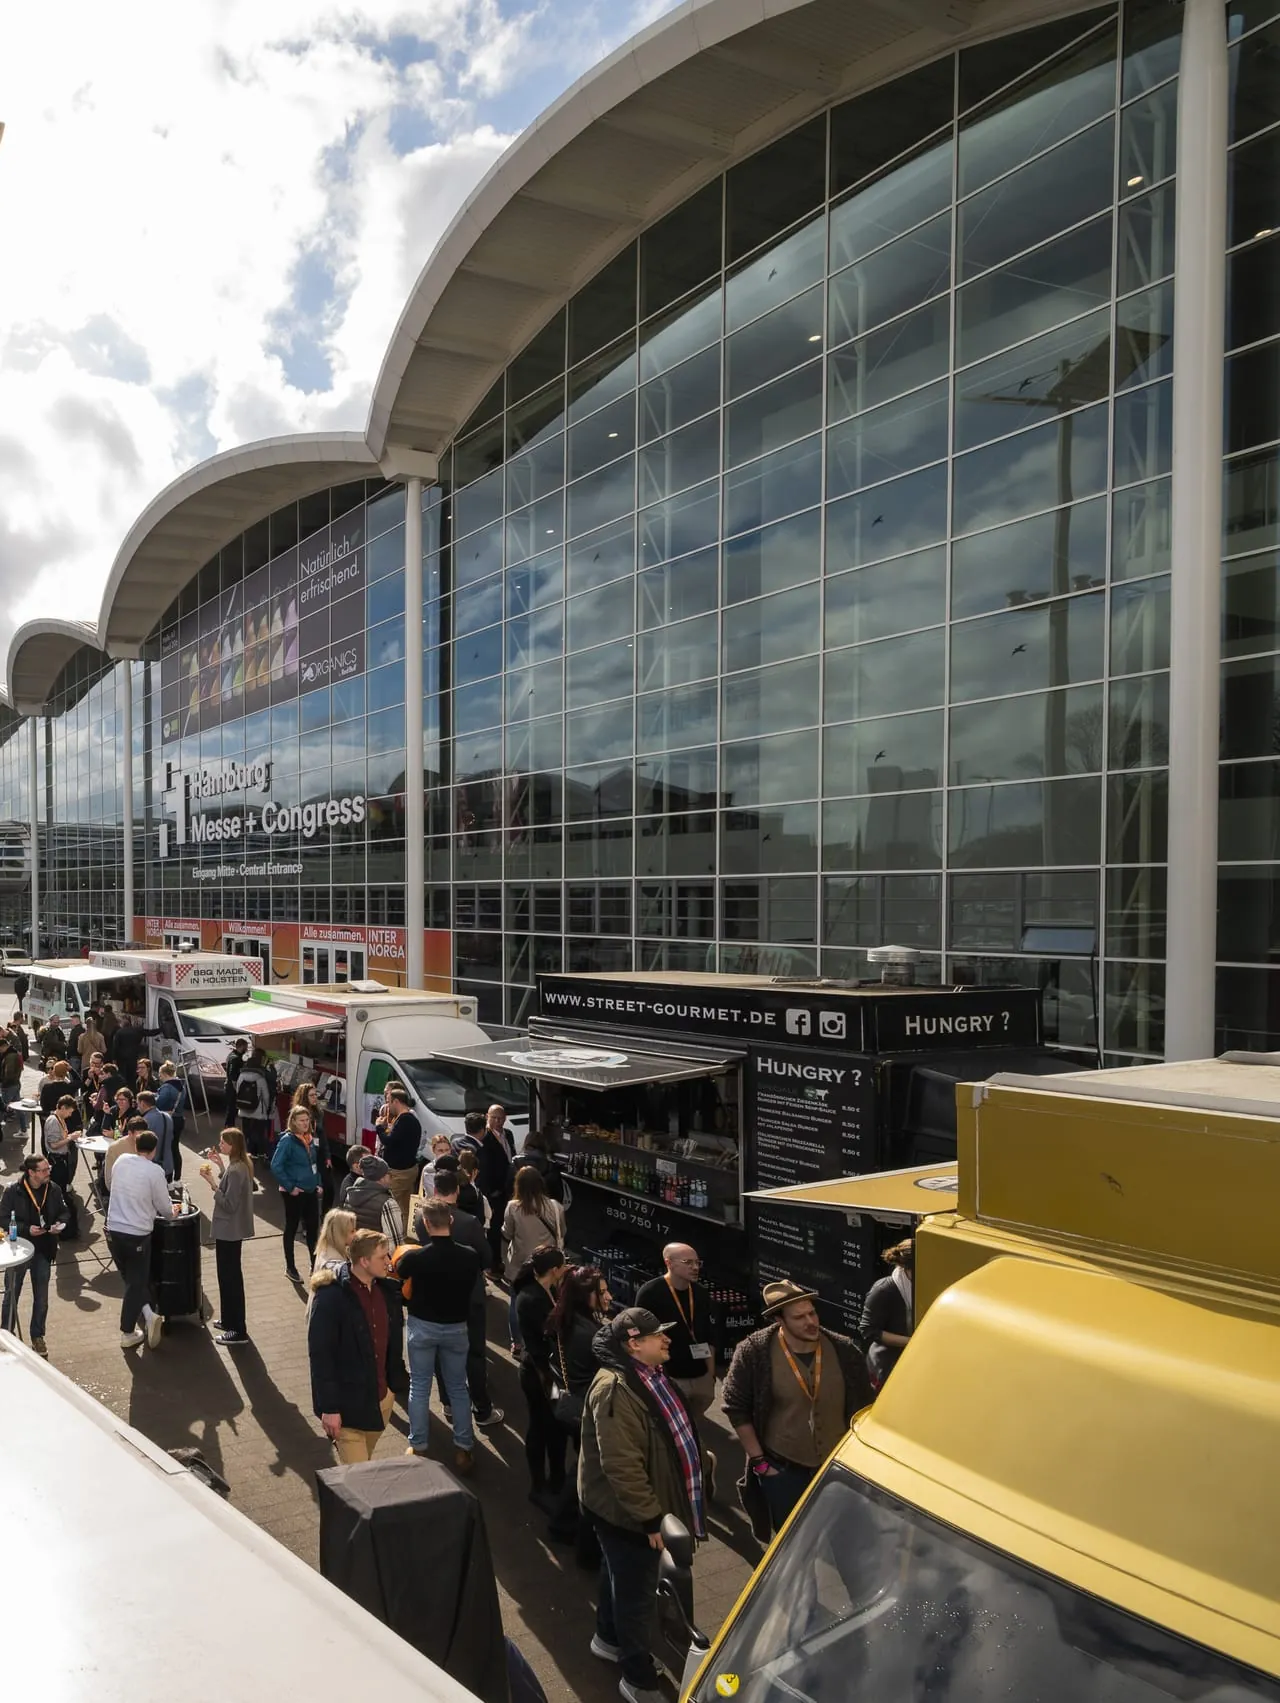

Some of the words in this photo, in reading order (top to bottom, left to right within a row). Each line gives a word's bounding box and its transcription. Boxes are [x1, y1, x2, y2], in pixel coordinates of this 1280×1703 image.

[300, 534, 350, 579] Natürlich
[301, 554, 360, 603] erfrischend.
[190, 759, 270, 800] Hamburg
[191, 814, 242, 844] Messe
[245, 812, 257, 834] +
[261, 796, 366, 838] Congress
[192, 866, 217, 881] Eingang
[239, 863, 267, 877] Central
[267, 862, 303, 875] Entrance
[303, 926, 317, 938] Alle
[319, 928, 365, 941] zusammen.
[368, 930, 397, 944] INTER
[368, 944, 405, 959] NORGA
[190, 976, 200, 985] IN
[202, 976, 248, 985] HOLSTEIN
[193, 969, 214, 977] BBQ
[216, 968, 244, 976] MADE
[1001, 1011, 1010, 1031] ?
[851, 1069, 862, 1086] ?
[620, 1198, 648, 1214] 0176
[606, 1207, 627, 1221] 830
[630, 1215, 652, 1229] 750
[656, 1223, 670, 1235] 17
